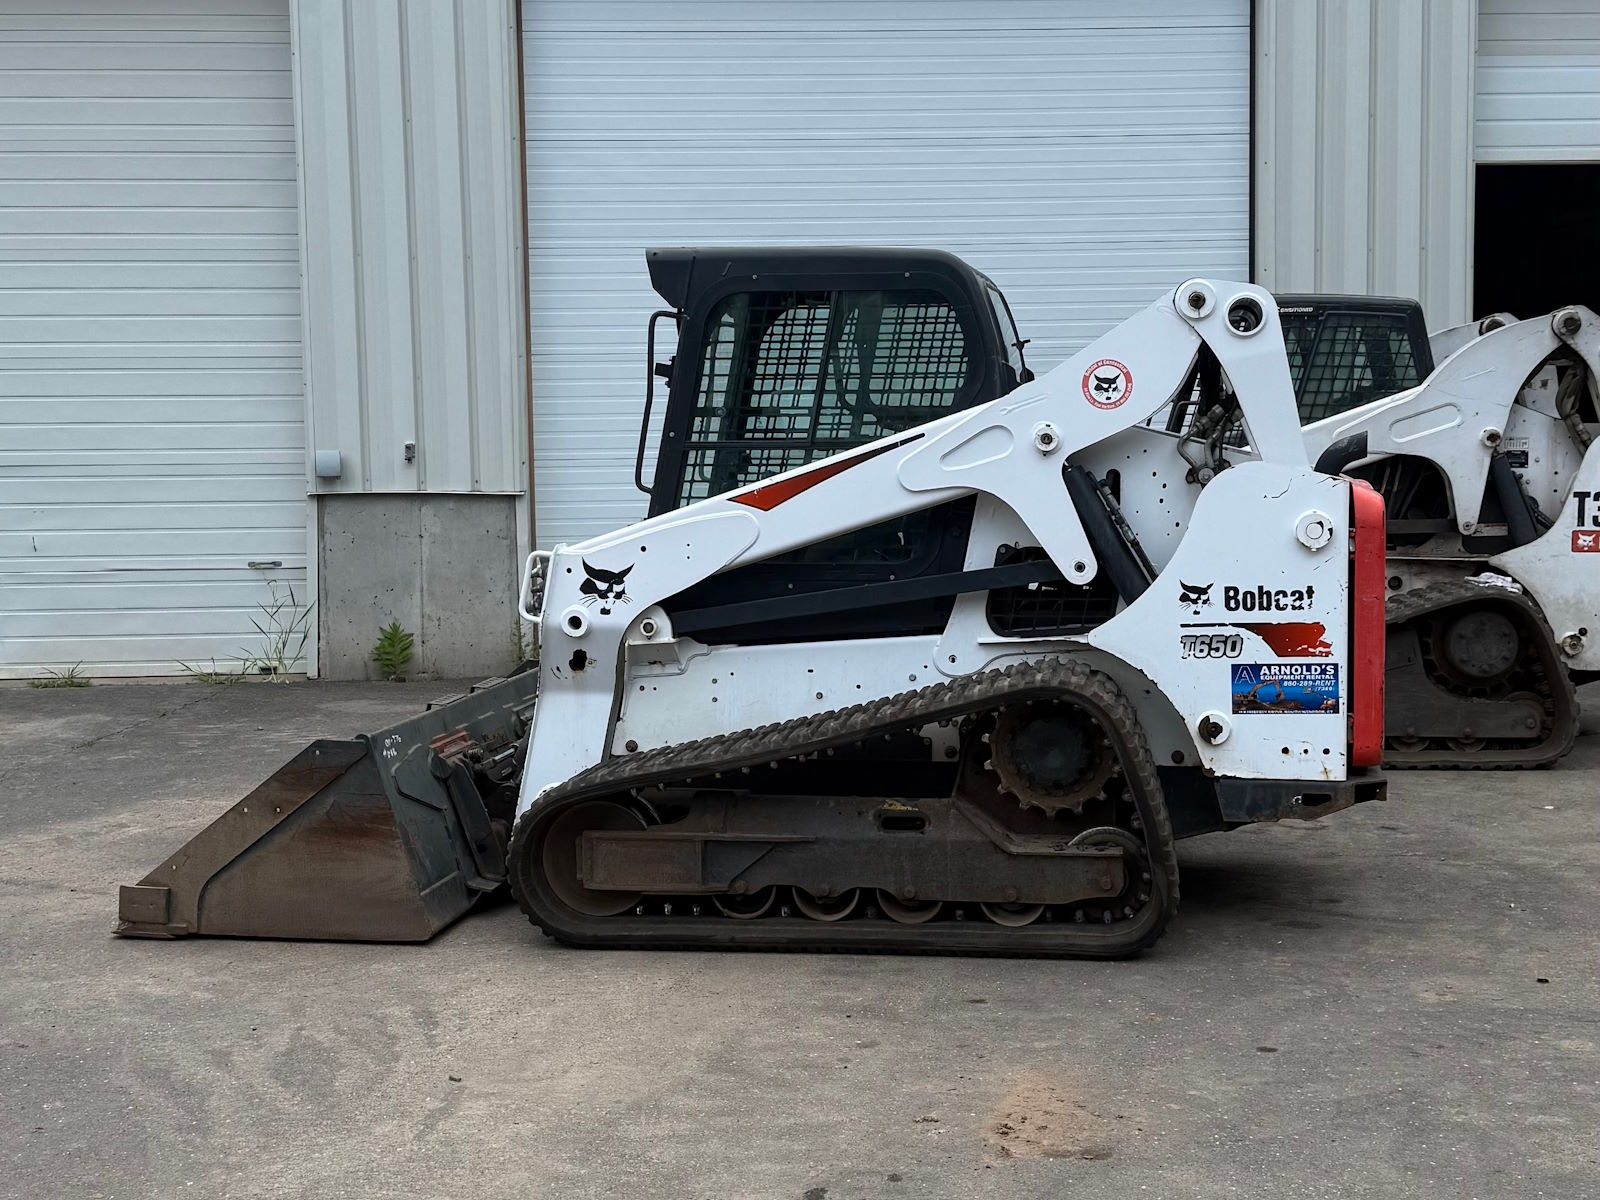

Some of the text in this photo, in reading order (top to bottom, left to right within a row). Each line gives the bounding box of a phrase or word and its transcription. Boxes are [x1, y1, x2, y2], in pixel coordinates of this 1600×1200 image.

[1224, 585, 1315, 611] Bobcat
[1180, 634, 1243, 659] T650
[1260, 665, 1335, 675] ARNOLD'S
